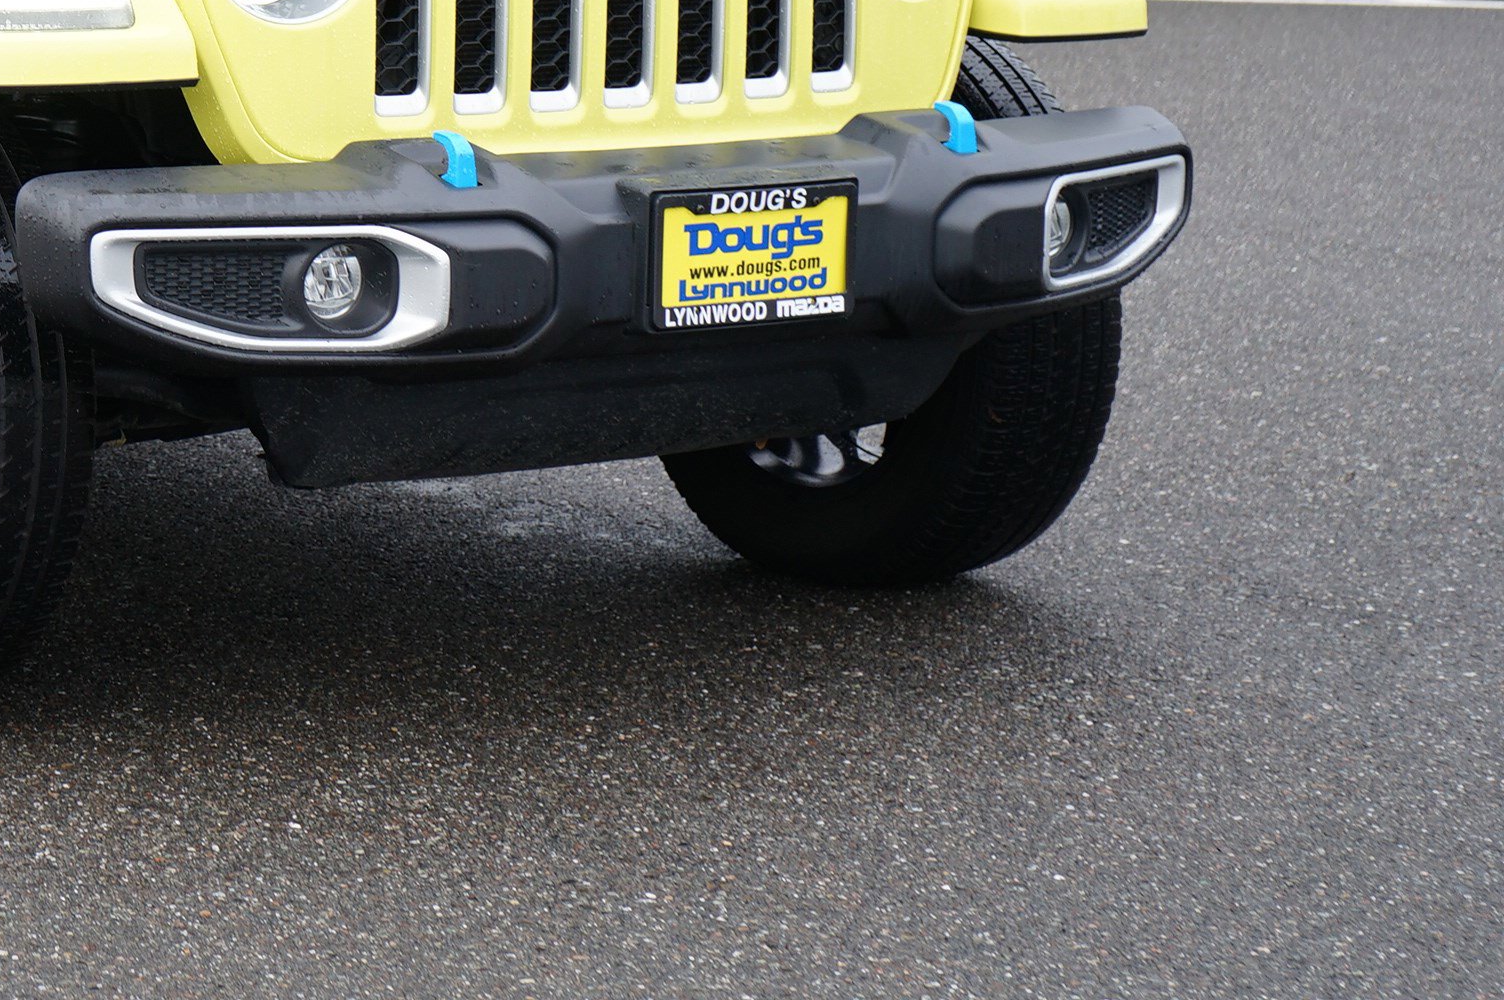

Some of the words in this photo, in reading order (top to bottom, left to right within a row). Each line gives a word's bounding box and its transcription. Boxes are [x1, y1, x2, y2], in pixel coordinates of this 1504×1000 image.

[710, 187, 808, 215] DOUG'S
[684, 215, 824, 260] Doug's
[690, 256, 821, 281] www.dougs.com
[679, 267, 828, 303] Lynnwood
[665, 301, 767, 328] LYNNWOOD
